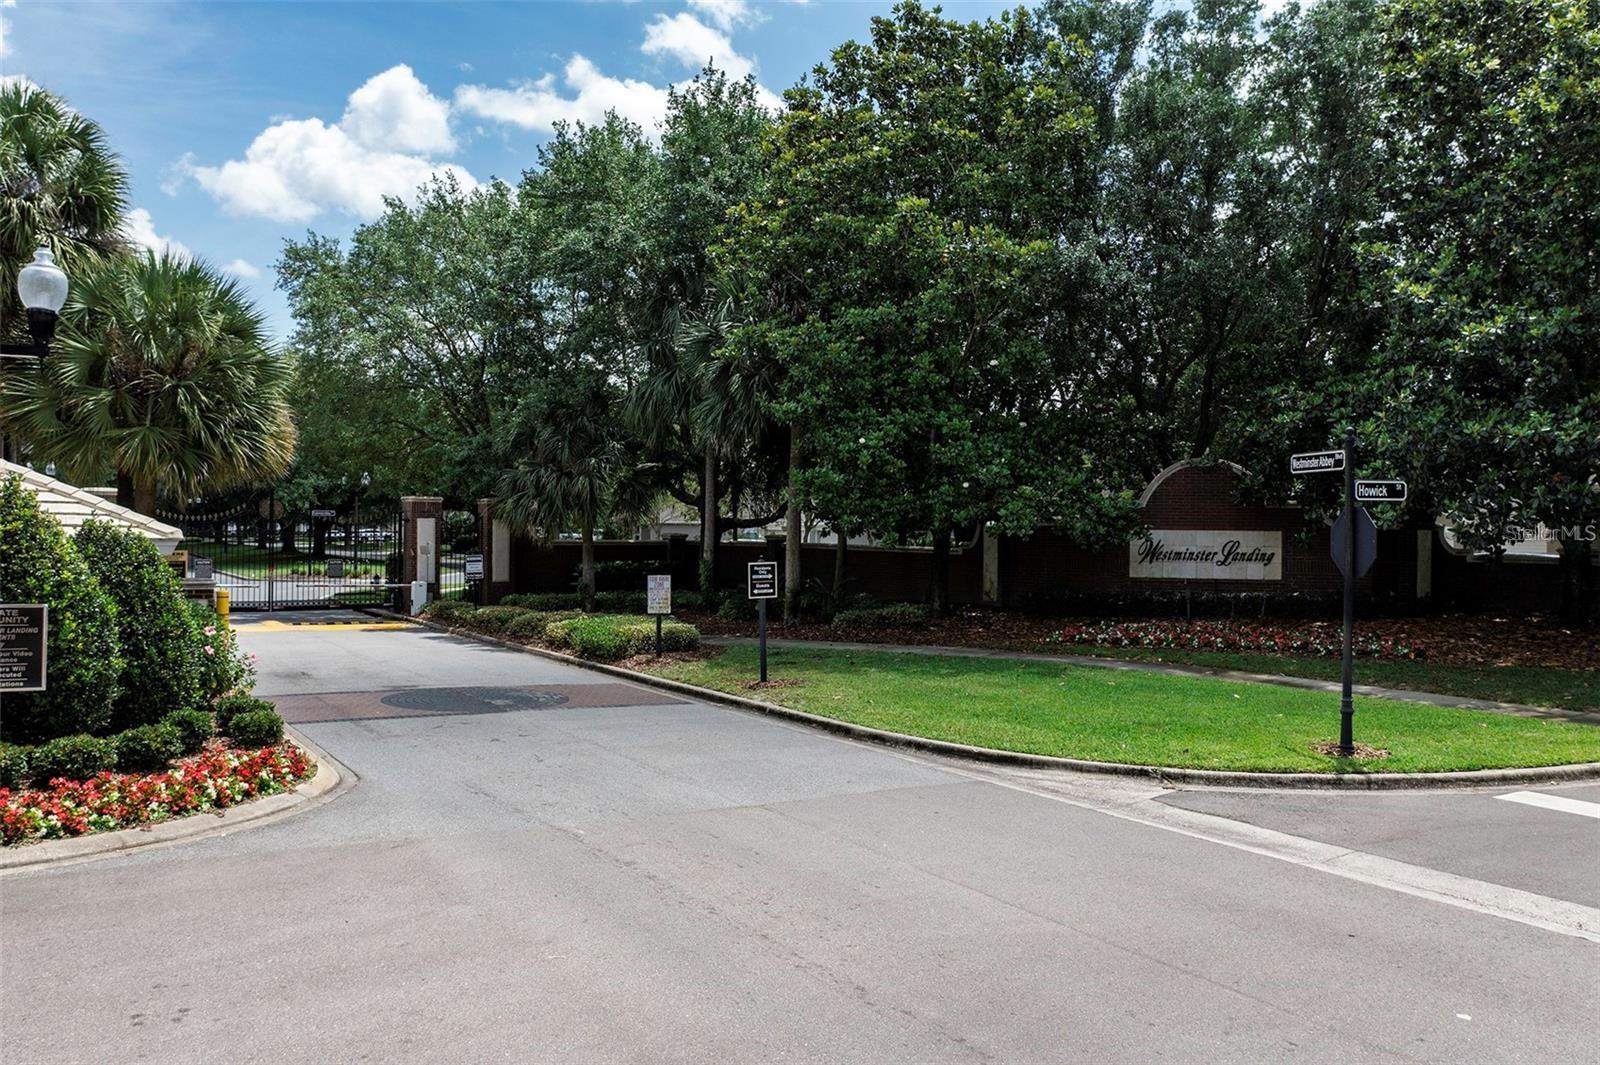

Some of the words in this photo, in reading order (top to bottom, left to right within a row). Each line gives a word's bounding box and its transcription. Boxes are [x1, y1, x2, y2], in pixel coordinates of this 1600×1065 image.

[1319, 455, 1334, 468] Abbey
[1358, 485, 1387, 497] Howick
[1138, 539, 1217, 564] Westminster
[1216, 540, 1276, 567] Landing
